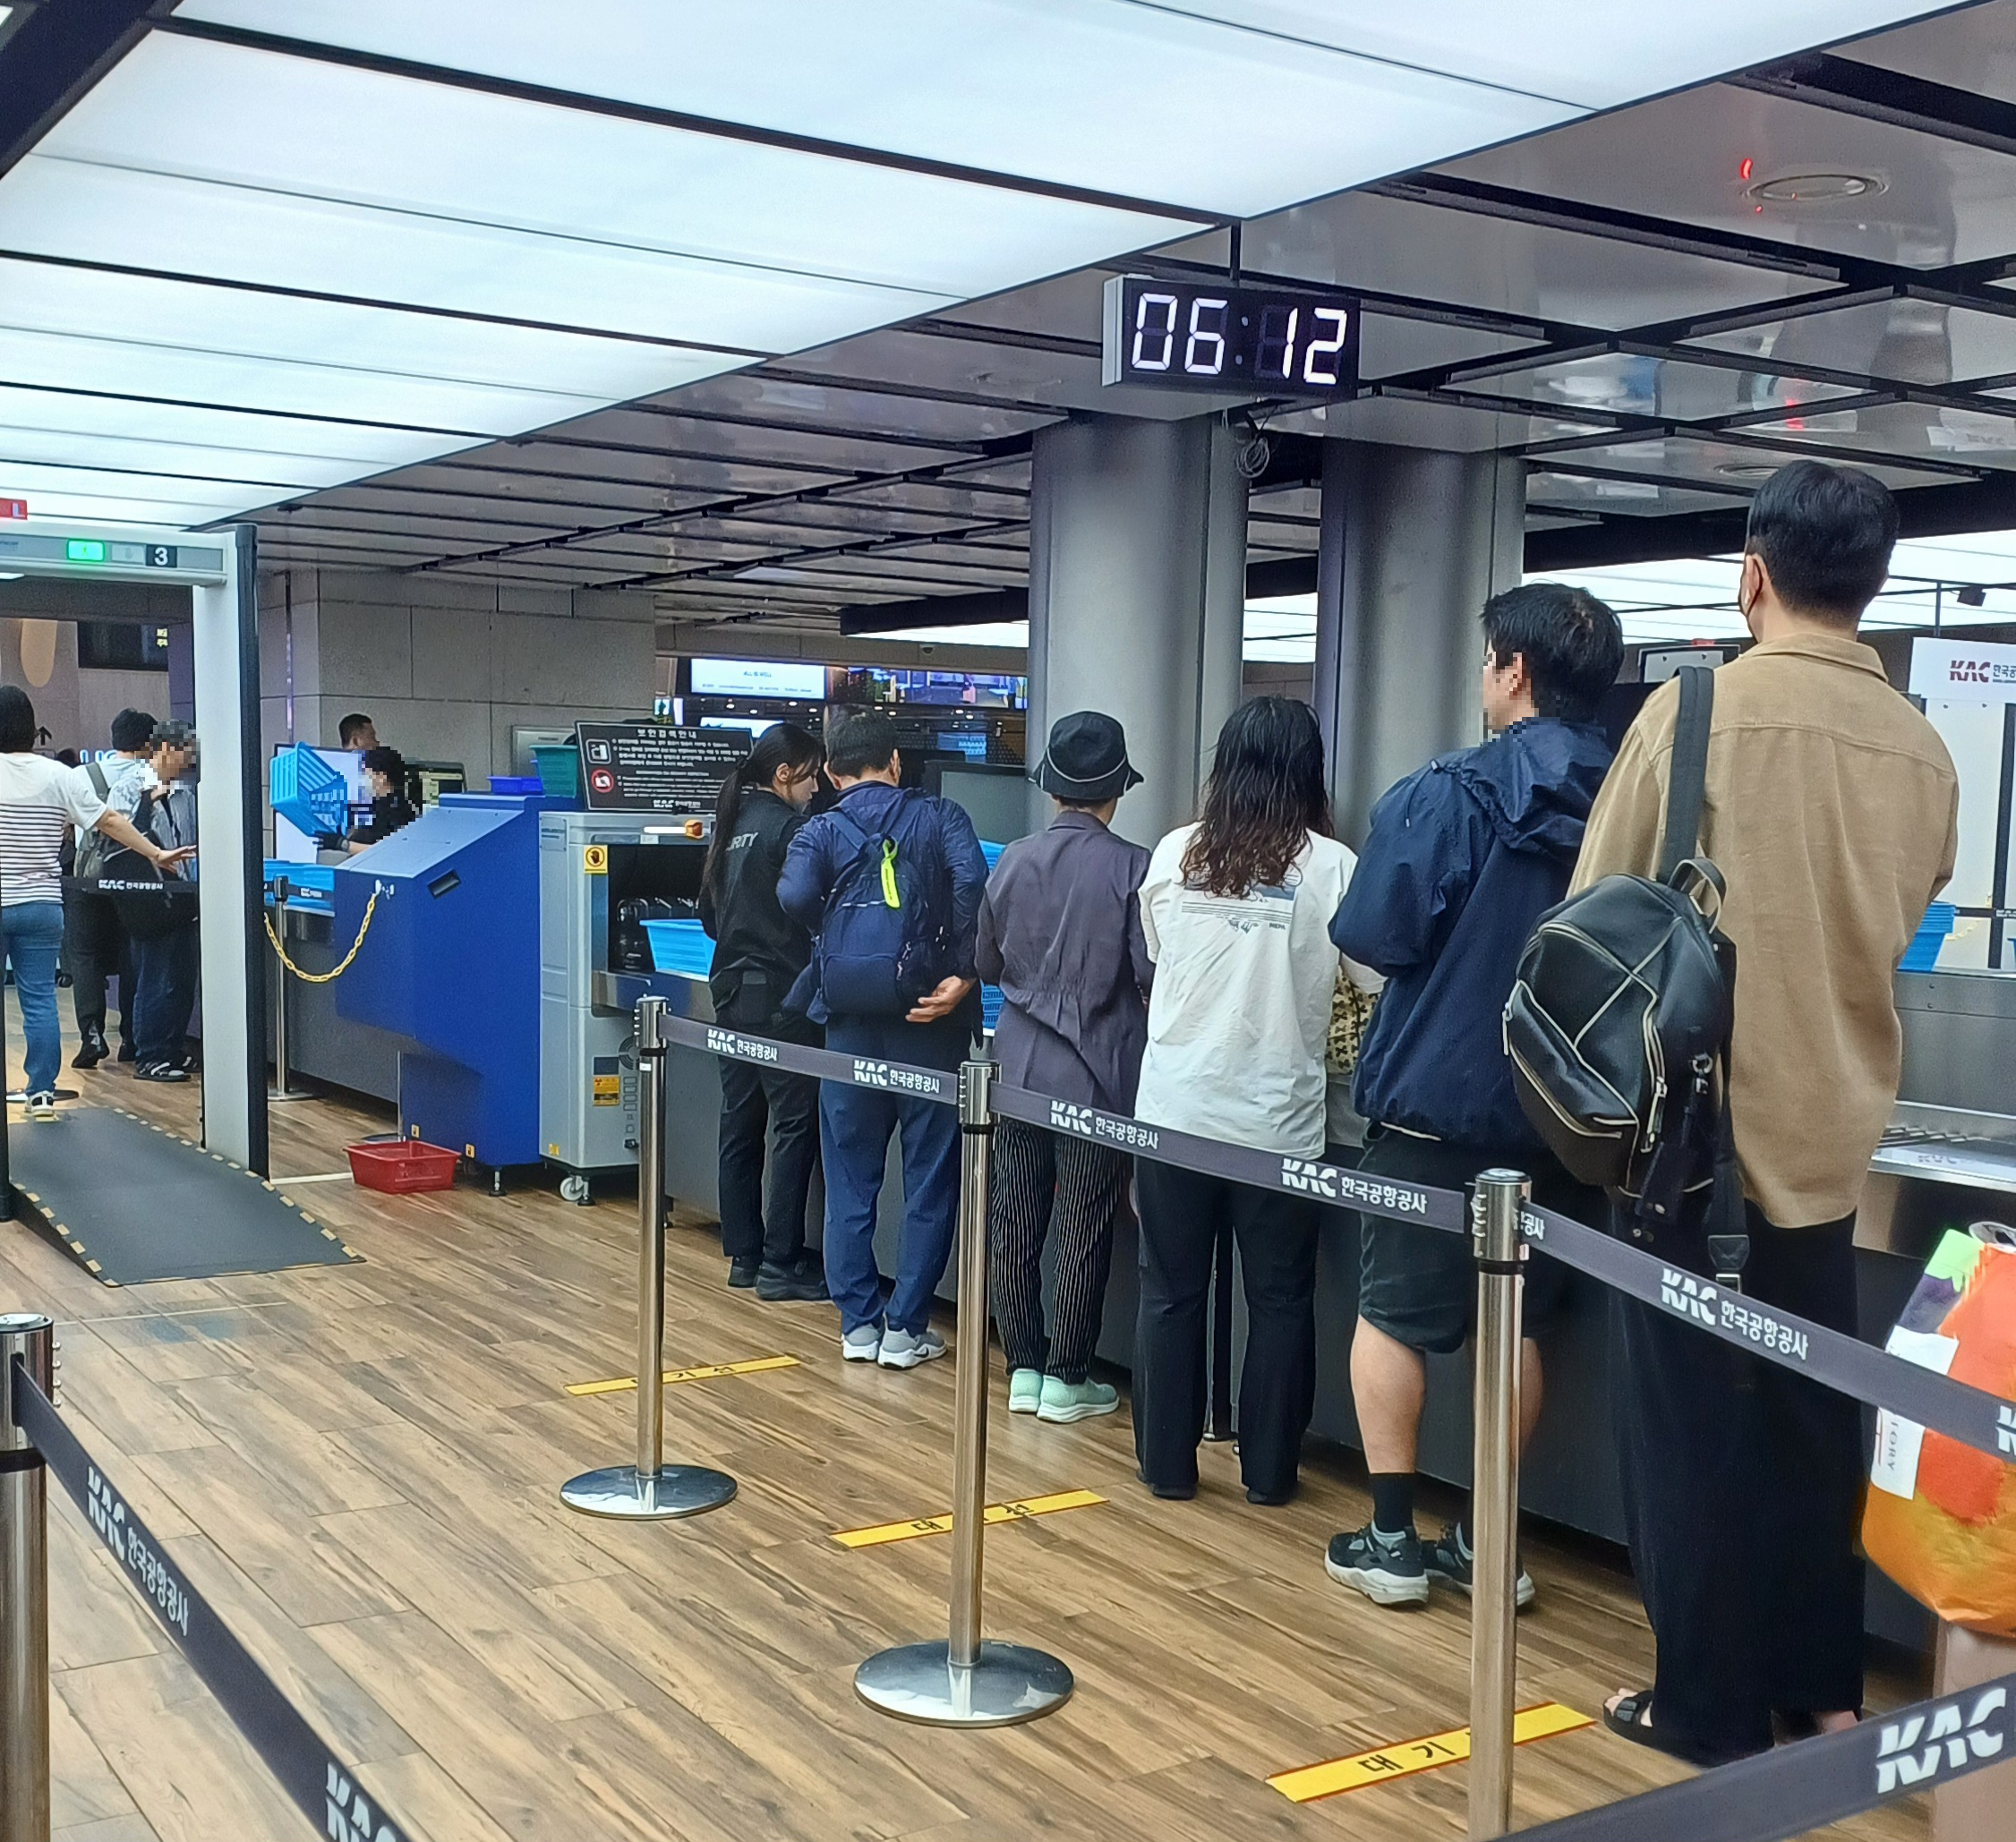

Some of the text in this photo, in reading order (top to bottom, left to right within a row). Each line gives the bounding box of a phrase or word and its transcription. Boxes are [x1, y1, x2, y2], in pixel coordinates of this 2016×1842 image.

[1132, 293, 1348, 385] 06:12
[154, 547, 168, 566] 3
[1949, 660, 1991, 683] KAC
[707, 1028, 778, 1062] KAC 한국공항공사
[853, 1059, 940, 1094] KAC 한국공항공사
[1050, 1100, 1159, 1150] KAC 한국공항공사
[1281, 1157, 1428, 1215] KAC 한국공항공사
[1661, 1267, 1809, 1361] KAC 한국공항공사
[88, 1466, 189, 1637] KAC 한국공항공사
[1875, 1687, 2007, 1795] KAC
